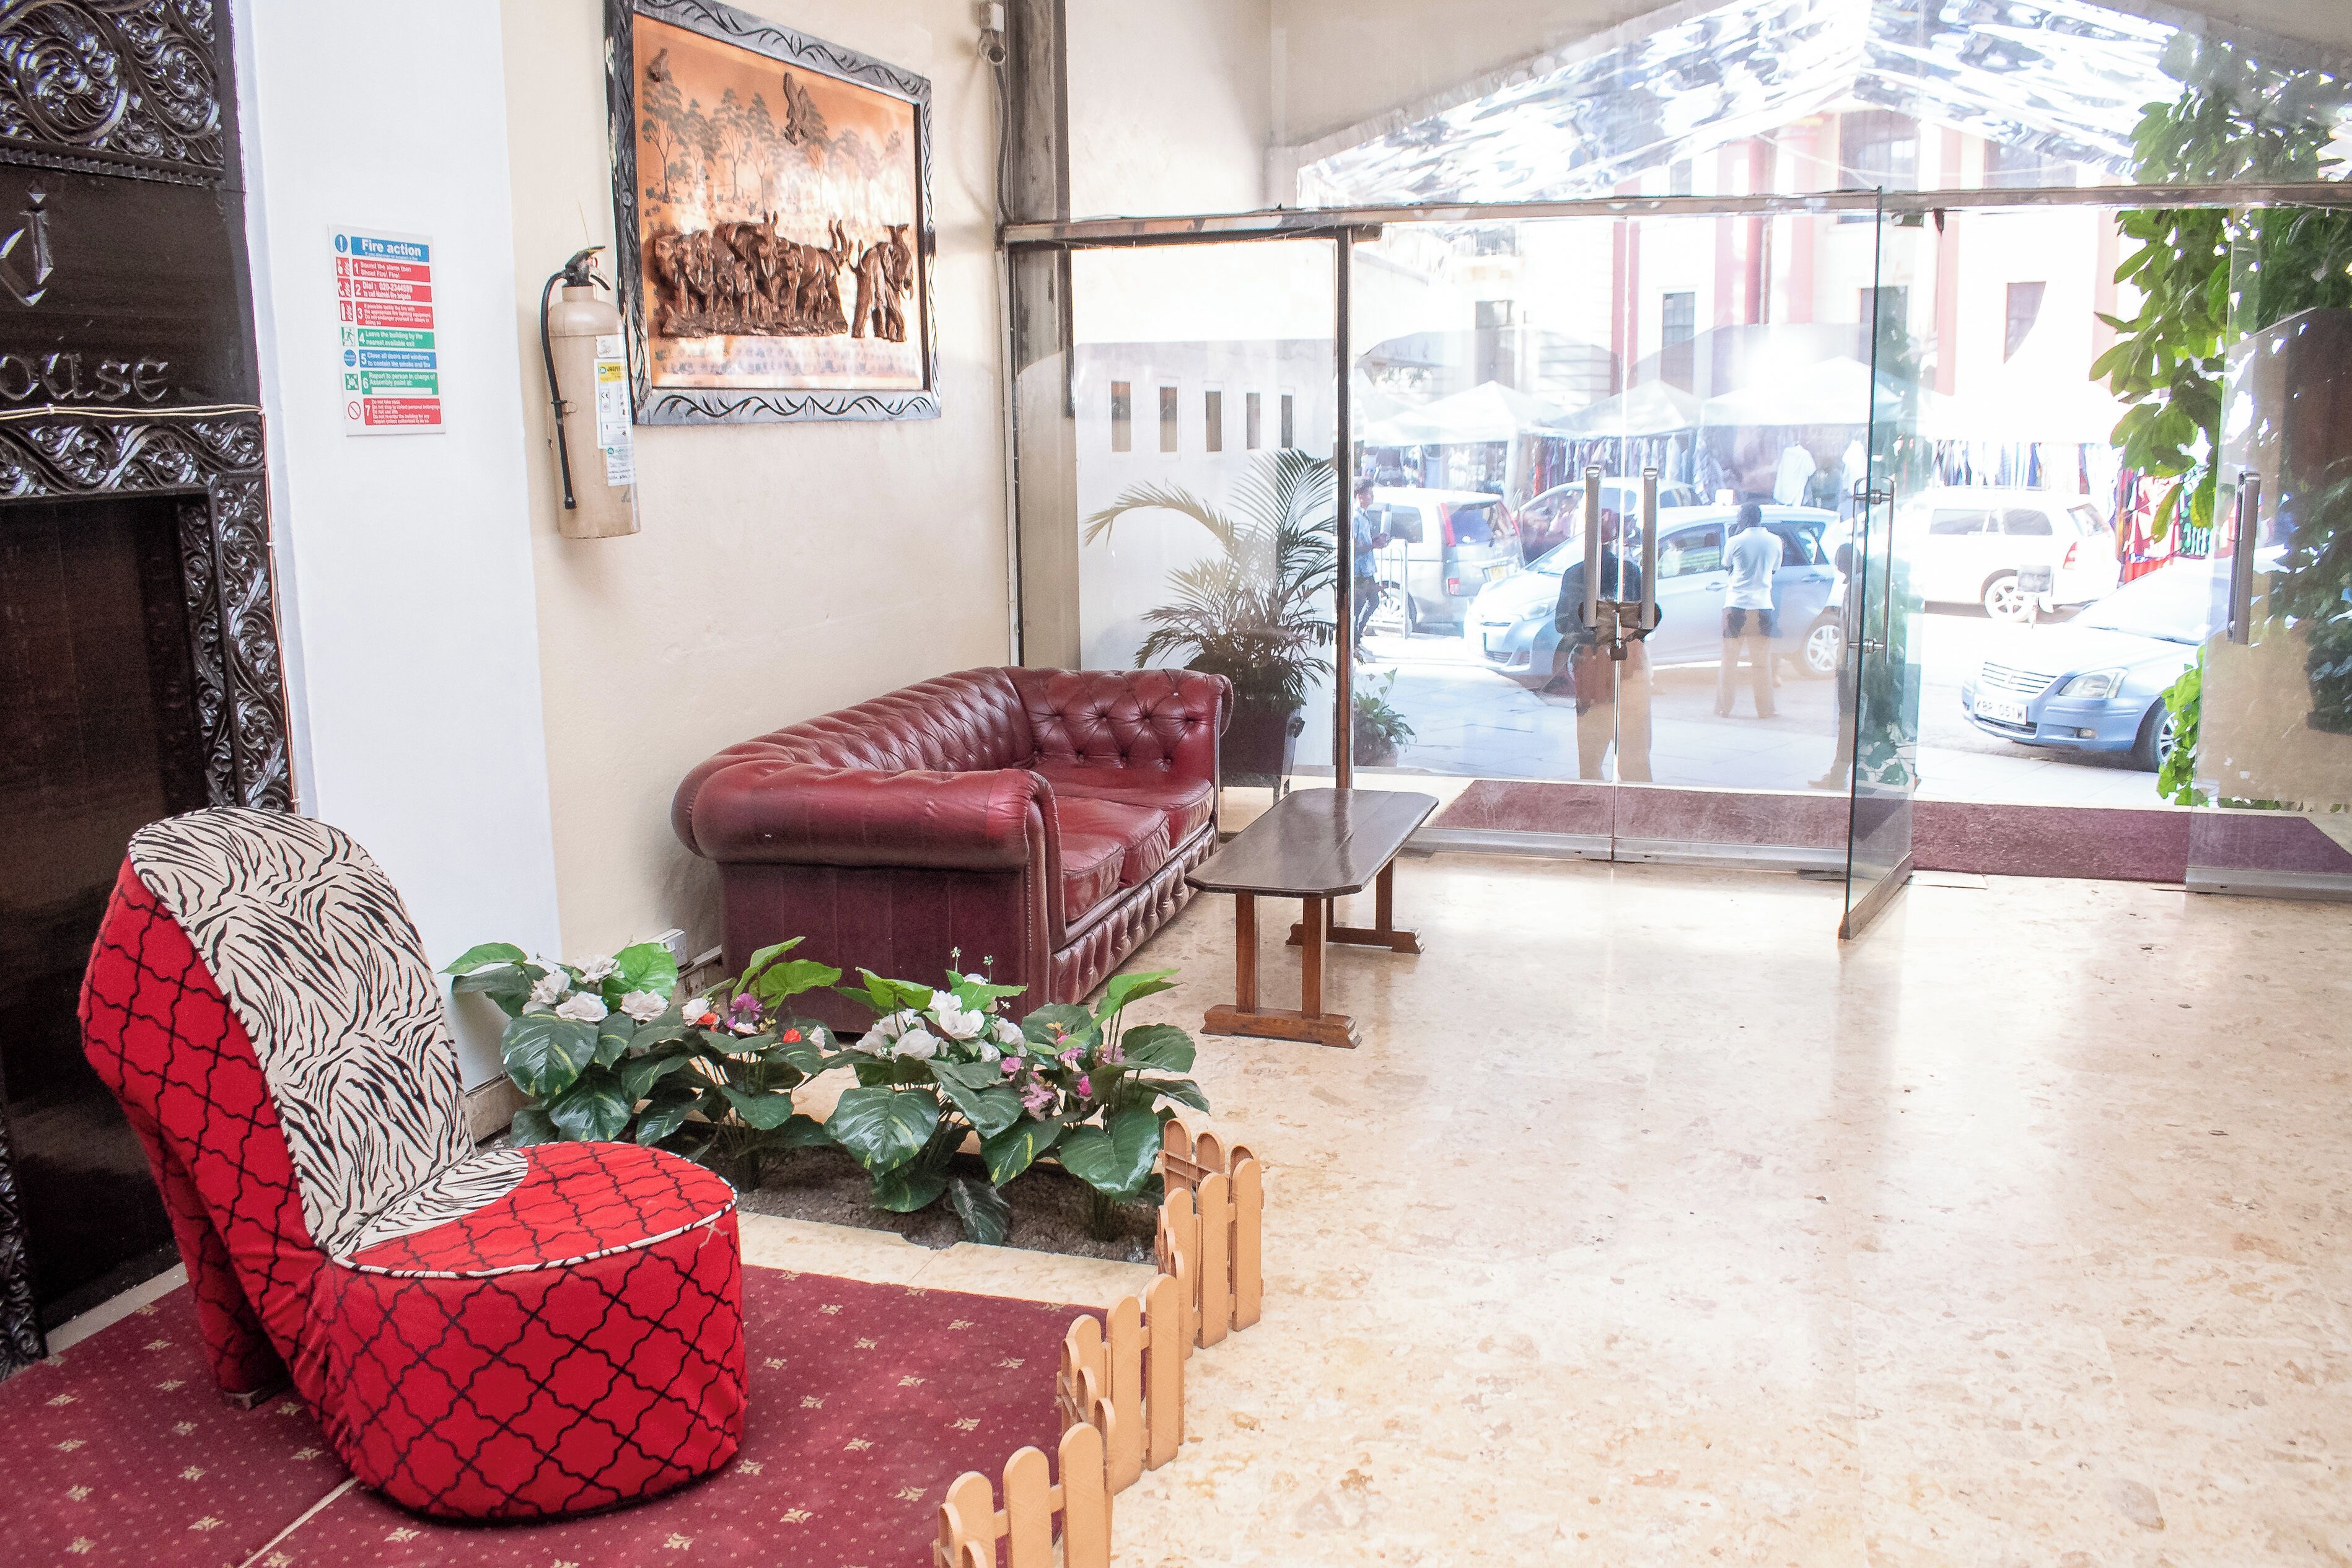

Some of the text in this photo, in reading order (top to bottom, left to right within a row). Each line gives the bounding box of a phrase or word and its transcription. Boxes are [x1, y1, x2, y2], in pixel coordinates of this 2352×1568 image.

[361, 238, 384, 253] Fire
[387, 243, 421, 257] action
[354, 262, 359, 274] 1
[361, 269, 376, 277] Shout
[355, 283, 362, 296] 2
[357, 307, 363, 320] 3
[359, 332, 366, 344] 4
[388, 331, 408, 339] building
[361, 353, 367, 365] 5
[362, 377, 369, 389] 6
[364, 405, 371, 417] 7
